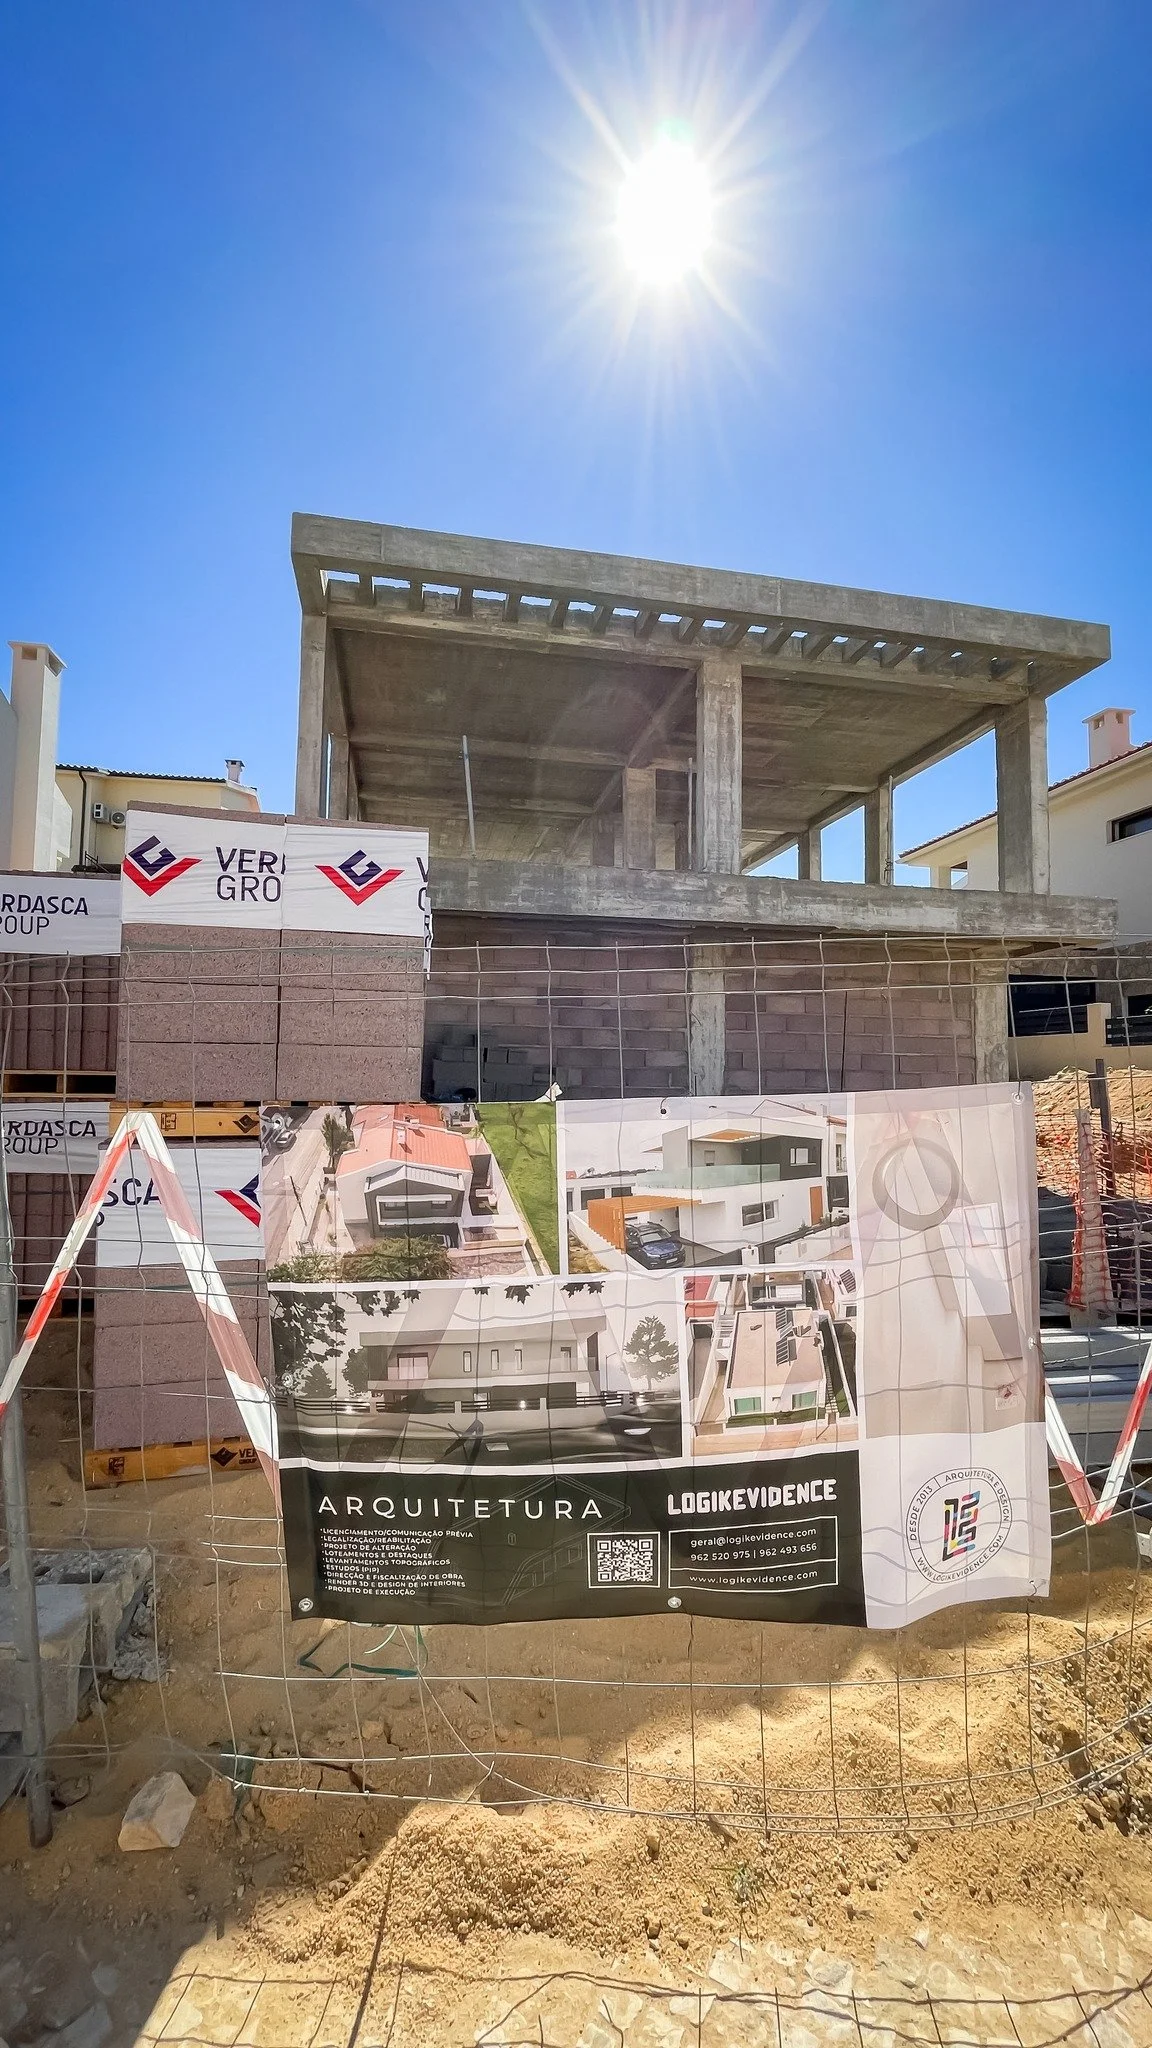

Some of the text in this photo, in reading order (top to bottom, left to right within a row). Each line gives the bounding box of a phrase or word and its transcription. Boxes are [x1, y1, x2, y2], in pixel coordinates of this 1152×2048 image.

[217, 874, 281, 902] GRO
[1, 893, 88, 916] RDASCA
[3, 1120, 96, 1137] RDASCA
[667, 1478, 838, 1516] LOGIKEVIDENCE
[945, 1470, 995, 1483] ARQUITETURA
[997, 1487, 1010, 1522] DESIGN
[318, 1496, 603, 1519] ARQUITETURA
[910, 1485, 933, 1541] DESDE 2013
[445, 1530, 473, 1538] PRÉVIA
[690, 1528, 817, 1548] geral@logikevidence.com
[324, 1550, 379, 1558] LOTEAMENTOS
[325, 1557, 389, 1566] LEVANTAMENTOS
[690, 1554, 709, 1562] 962
[712, 1552, 730, 1561] 520
[733, 1551, 751, 1560] 975
[759, 1548, 777, 1558] 962
[780, 1545, 797, 1554] 493
[800, 1543, 817, 1553] 656
[917, 1534, 1004, 1582] WWW.LOGIKEVIDENCE.COM
[326, 1564, 360, 1572] ESTUDOS
[326, 1571, 365, 1579] DIRECÇÃO
[689, 1569, 818, 1585] www.logikevidence.com
[327, 1578, 358, 1586] RENDER
[421, 1580, 466, 1588] INTERIORES
[328, 1585, 361, 1594] PROJETO
[375, 1588, 416, 1596] EXECUÇÃO
